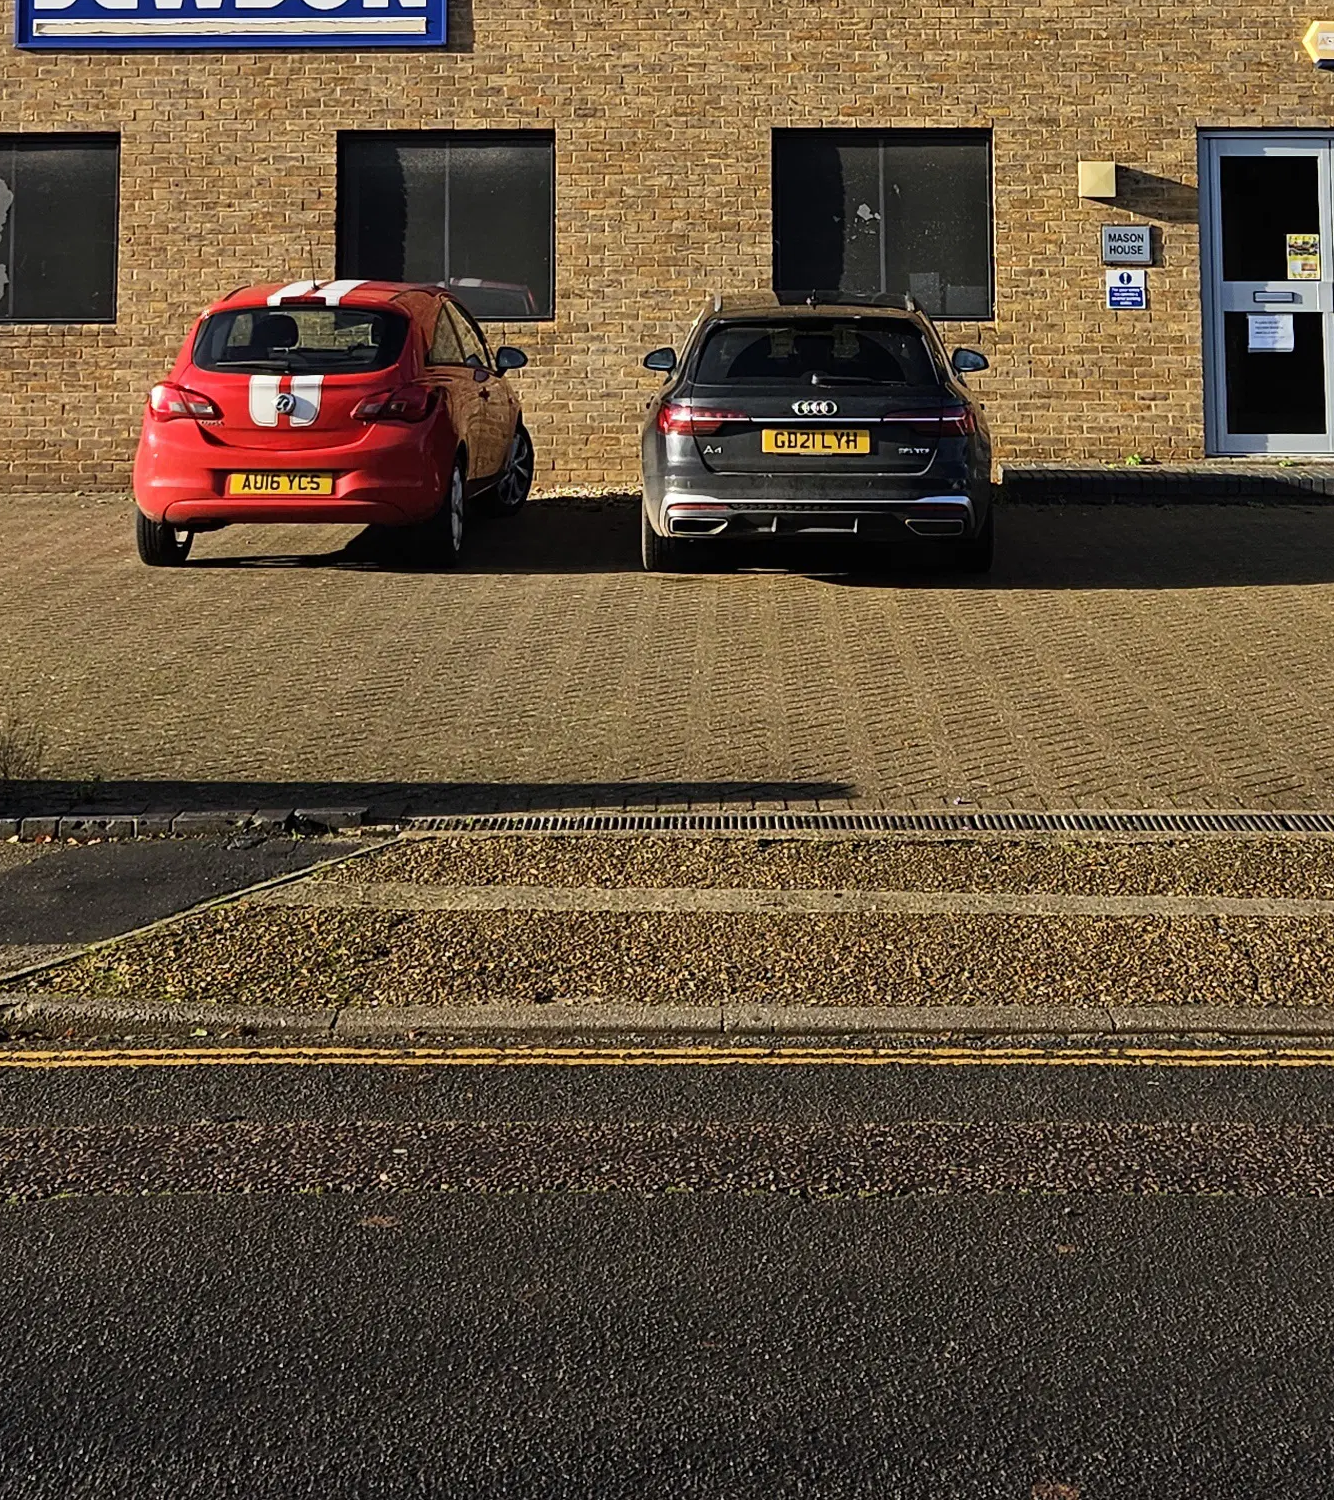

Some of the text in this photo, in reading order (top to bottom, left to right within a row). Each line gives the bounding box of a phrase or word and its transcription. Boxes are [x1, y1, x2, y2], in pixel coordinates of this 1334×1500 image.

[1108, 233, 1144, 243] MASON
[1109, 245, 1144, 255] HOUSE
[821, 432, 858, 449] LYH
[702, 445, 722, 455] A4
